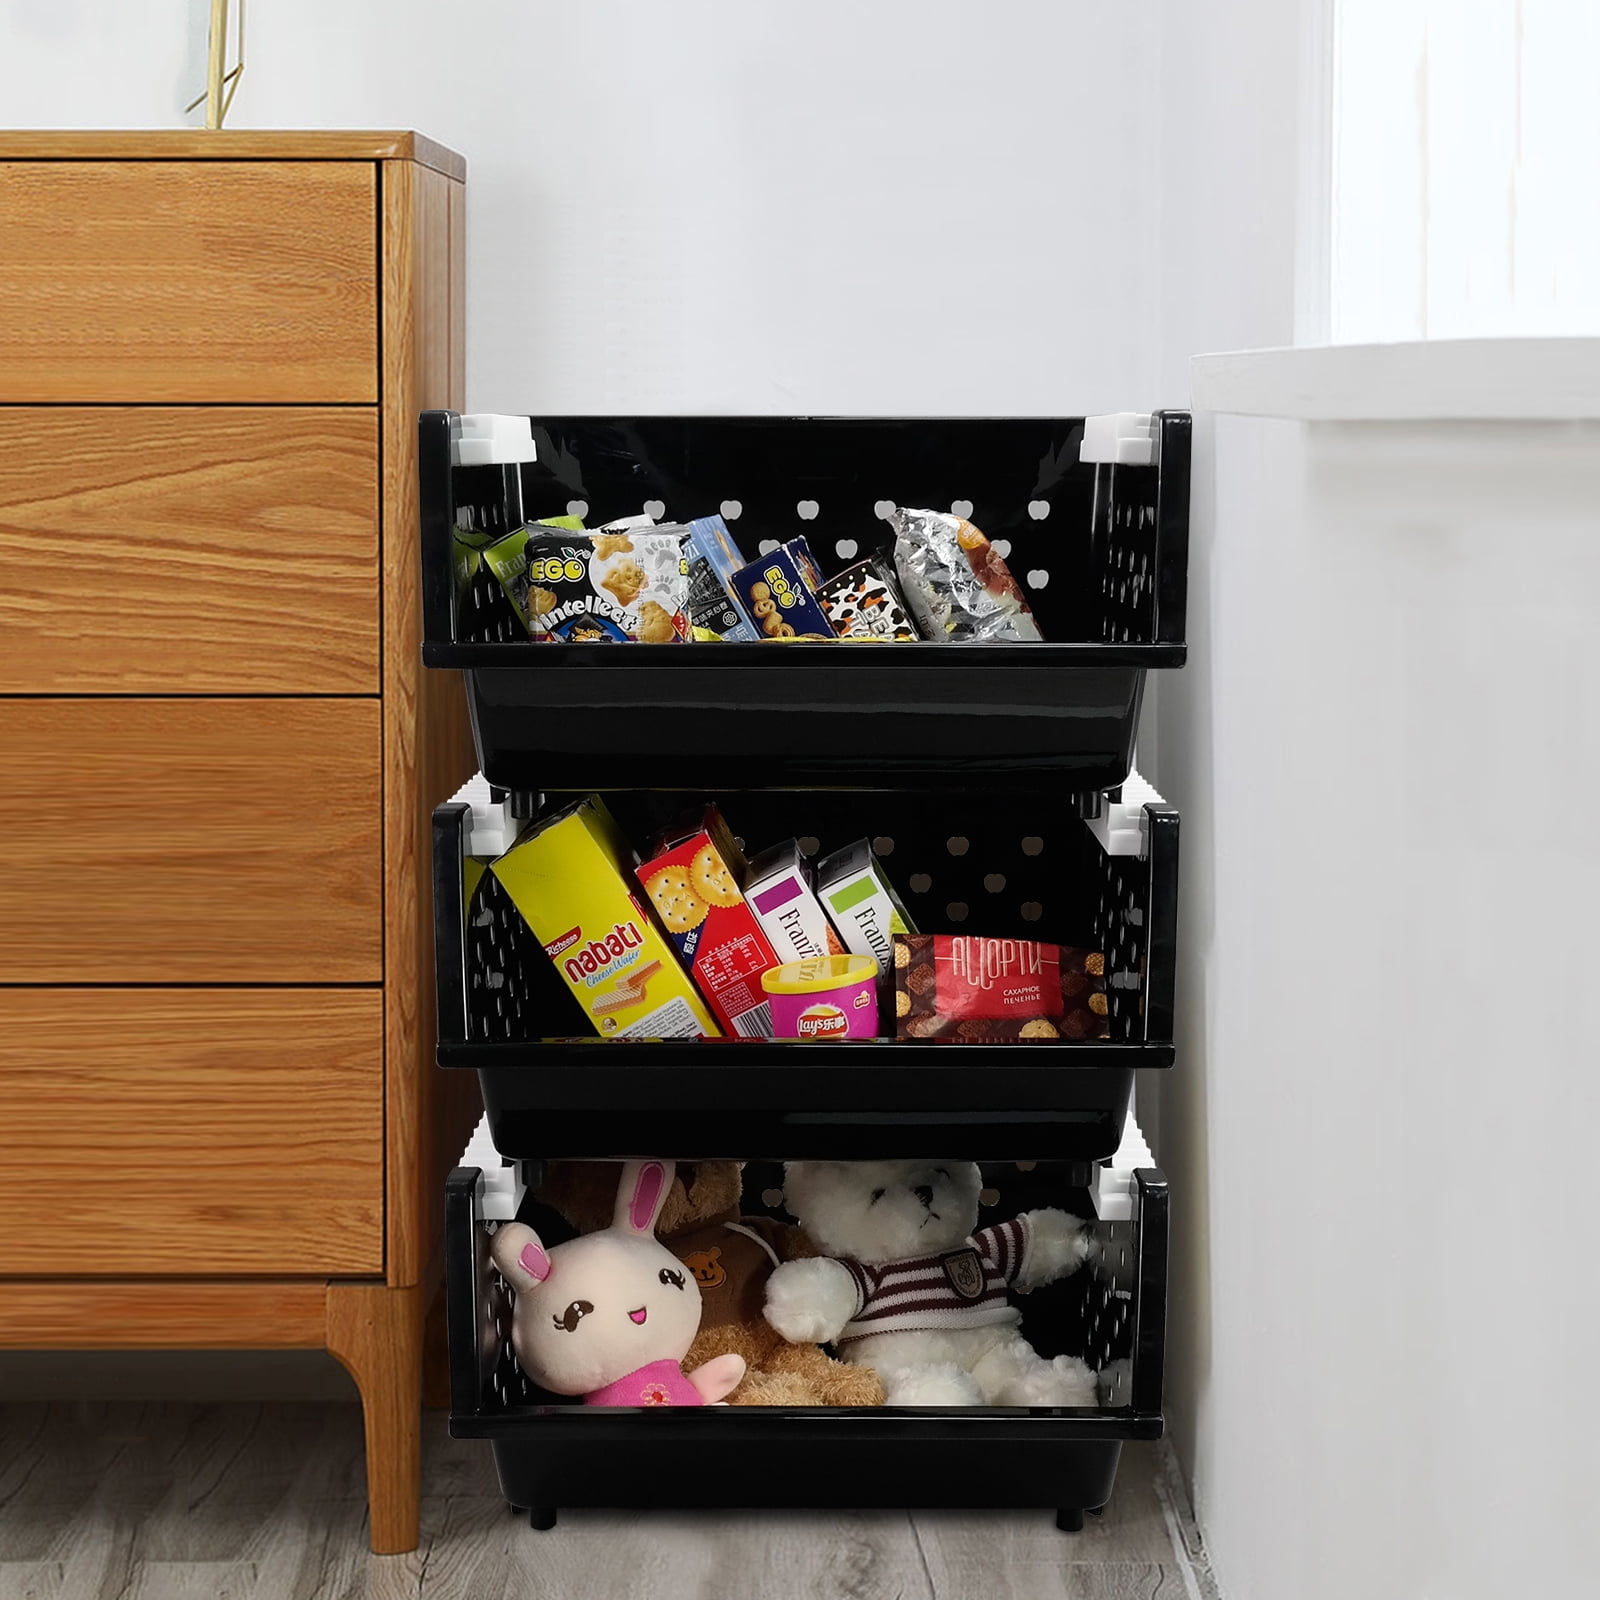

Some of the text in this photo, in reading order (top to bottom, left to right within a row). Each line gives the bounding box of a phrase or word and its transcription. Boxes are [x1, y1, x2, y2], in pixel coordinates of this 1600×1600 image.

[530, 556, 585, 582] EGO
[764, 565, 797, 608] EGO
[539, 595, 638, 631] Intellect
[564, 922, 644, 983] nabati
[683, 931, 698, 955] 原味
[586, 949, 641, 988] Cheese Wafer
[952, 936, 1043, 990] АССОРТИ
[1003, 985, 1041, 997] САХАРНОЕ
[1004, 993, 1041, 1006] ПЕЧЕНЬЕ
